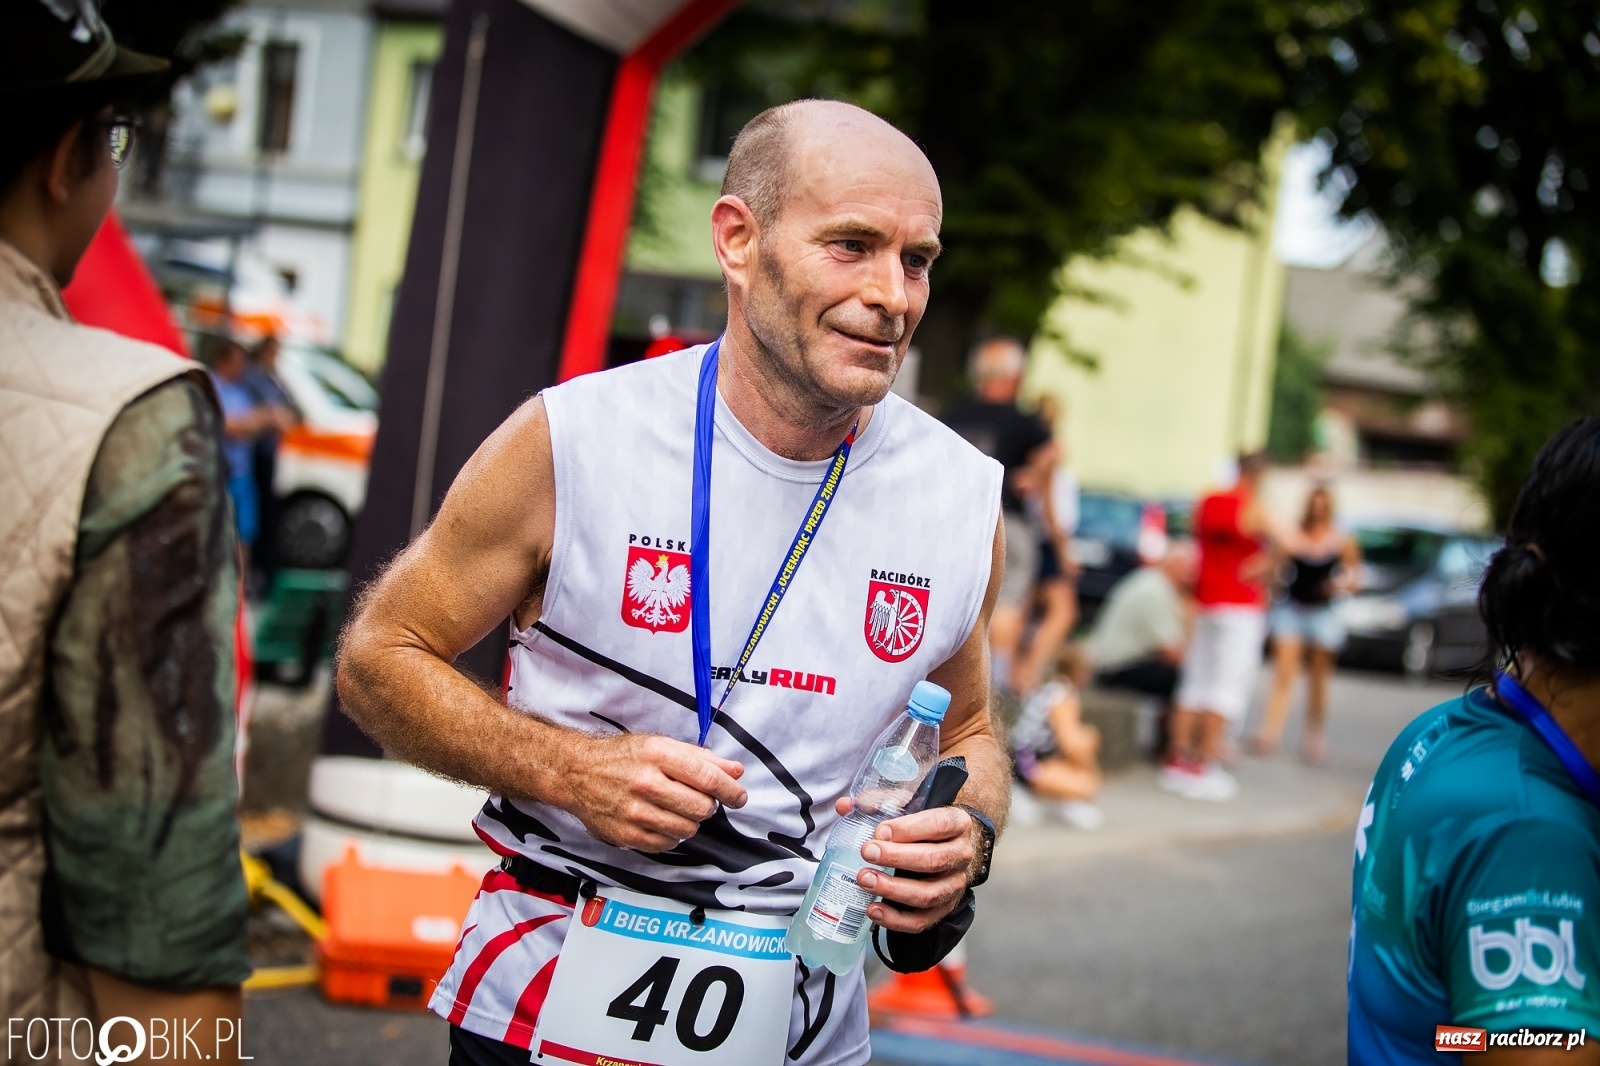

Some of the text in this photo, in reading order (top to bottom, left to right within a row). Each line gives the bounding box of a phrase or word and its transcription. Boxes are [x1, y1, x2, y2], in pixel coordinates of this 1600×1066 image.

[629, 534, 691, 553] POLSK
[740, 592, 780, 665] KRZANOWICKI
[804, 499, 826, 535] PRZED
[871, 568, 930, 588] RACIBÓRZ
[603, 908, 613, 924] I
[613, 910, 661, 935] BIEG
[606, 955, 745, 1052] 40
